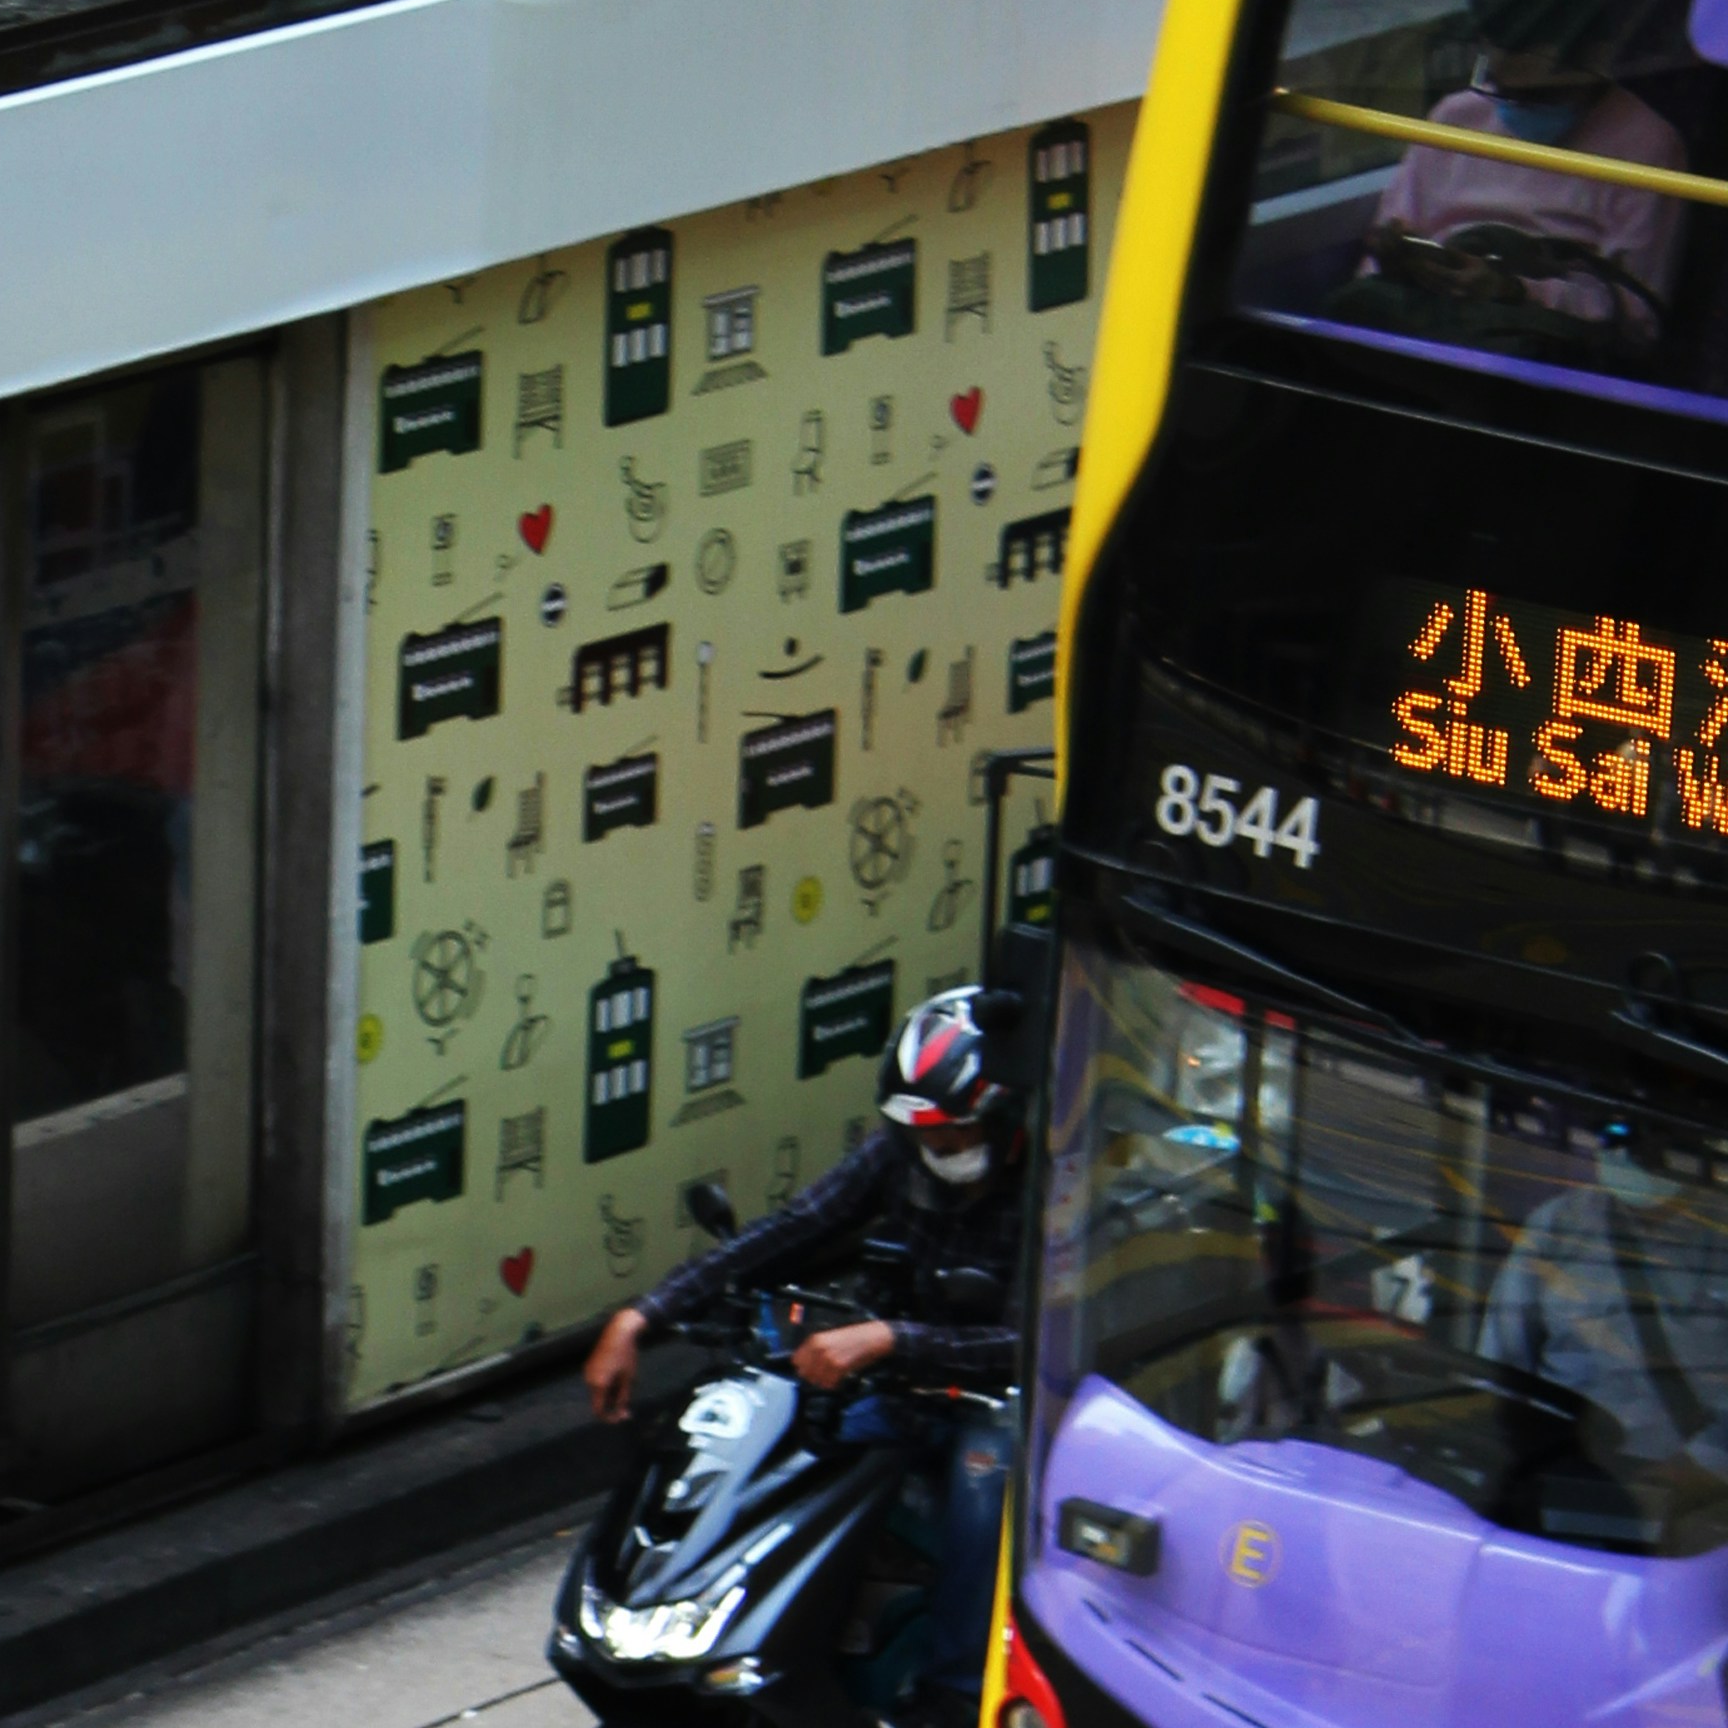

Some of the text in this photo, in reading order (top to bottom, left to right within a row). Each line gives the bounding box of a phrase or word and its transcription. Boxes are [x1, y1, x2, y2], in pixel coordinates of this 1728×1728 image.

[1407, 588, 1728, 748] 小西
[1389, 691, 1510, 786] Siu
[1529, 719, 1652, 817] Sai
[1155, 762, 1322, 870] 8544
[1229, 1524, 1271, 1581] E
